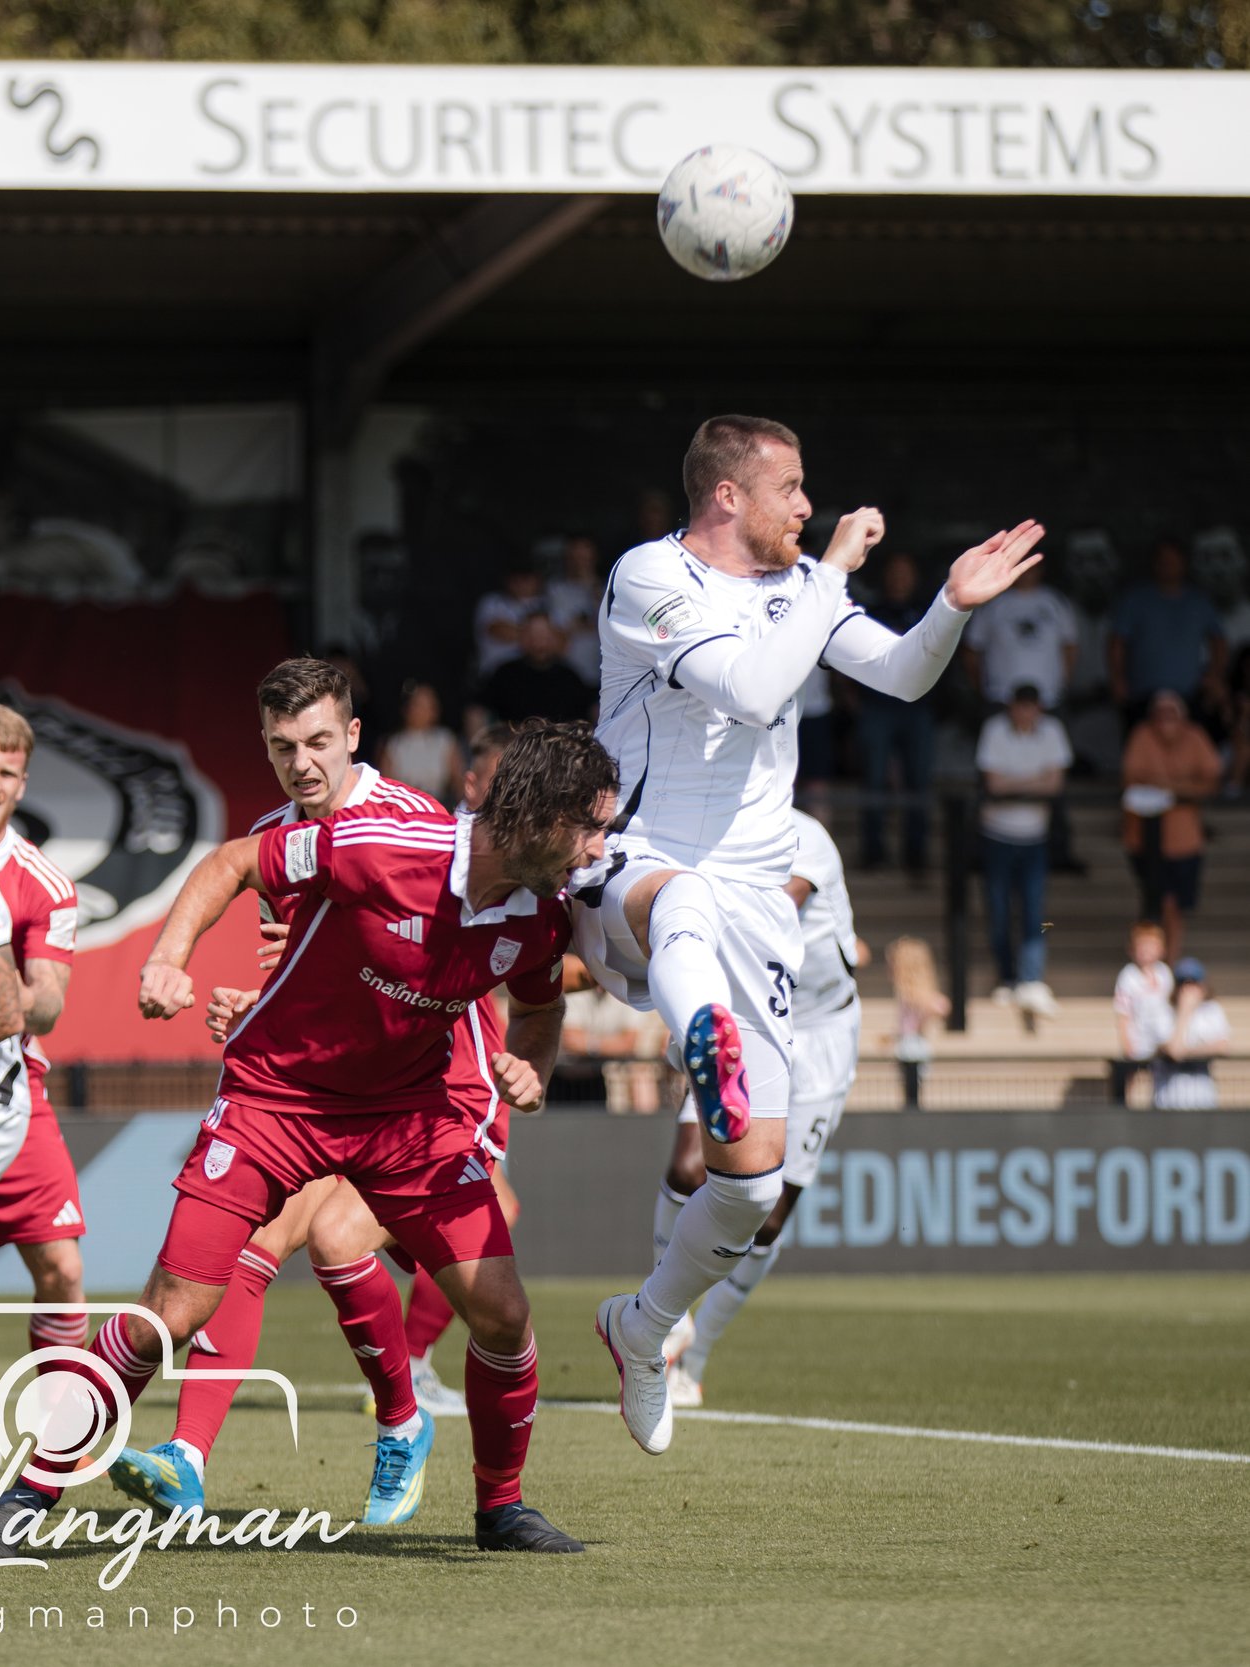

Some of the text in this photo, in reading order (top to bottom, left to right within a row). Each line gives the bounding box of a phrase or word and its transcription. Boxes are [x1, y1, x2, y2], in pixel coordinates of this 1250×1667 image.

[196, 76, 1161, 181] SECURITEC SYSTEMS
[803, 1117, 827, 1152] 5
[779, 1146, 1250, 1249] EDNESFORD
